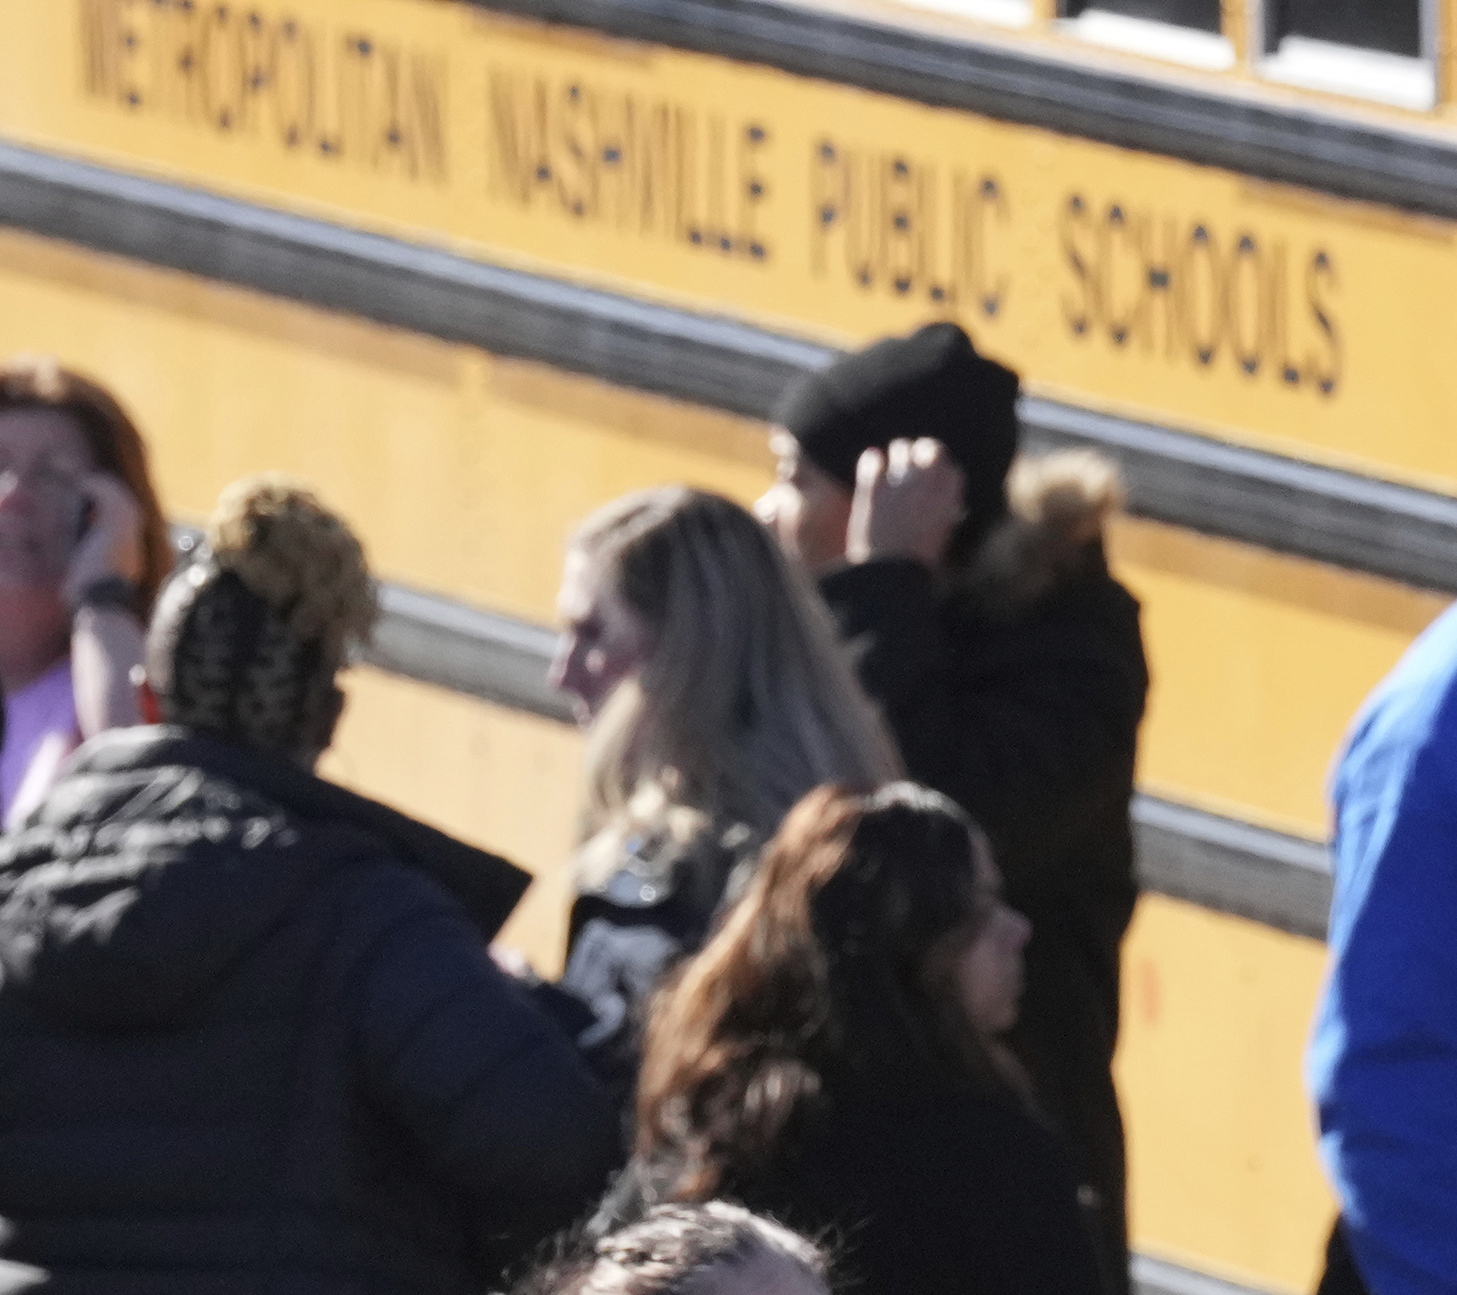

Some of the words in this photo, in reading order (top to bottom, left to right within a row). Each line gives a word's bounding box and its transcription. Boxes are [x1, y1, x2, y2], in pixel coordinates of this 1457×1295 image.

[77, 0, 449, 186] METROPOLITAN
[485, 64, 771, 264] NASHVILLE
[807, 130, 1013, 320] PUBLIC
[1055, 186, 1342, 400] SCHOOLS
